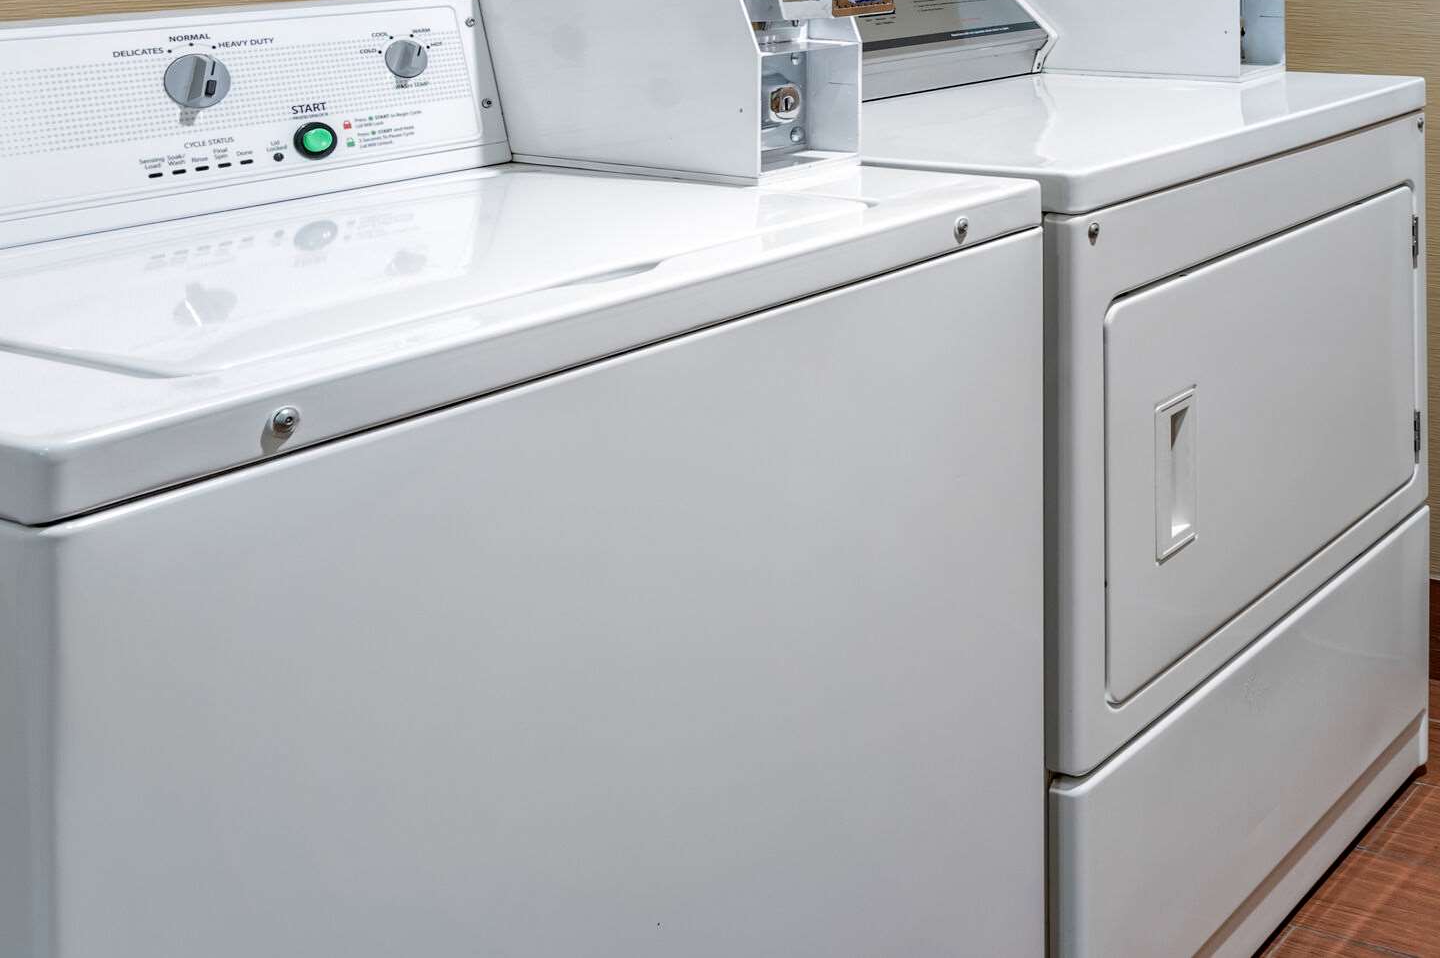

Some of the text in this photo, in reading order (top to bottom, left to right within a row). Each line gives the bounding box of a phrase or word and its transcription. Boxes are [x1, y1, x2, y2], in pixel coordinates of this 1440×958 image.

[168, 33, 211, 42] NORMAL
[217, 37, 275, 49] HEAVY DUTY
[112, 47, 164, 58] DELICATES
[291, 102, 328, 115] START
[184, 137, 235, 149] CYCLE STATUS
